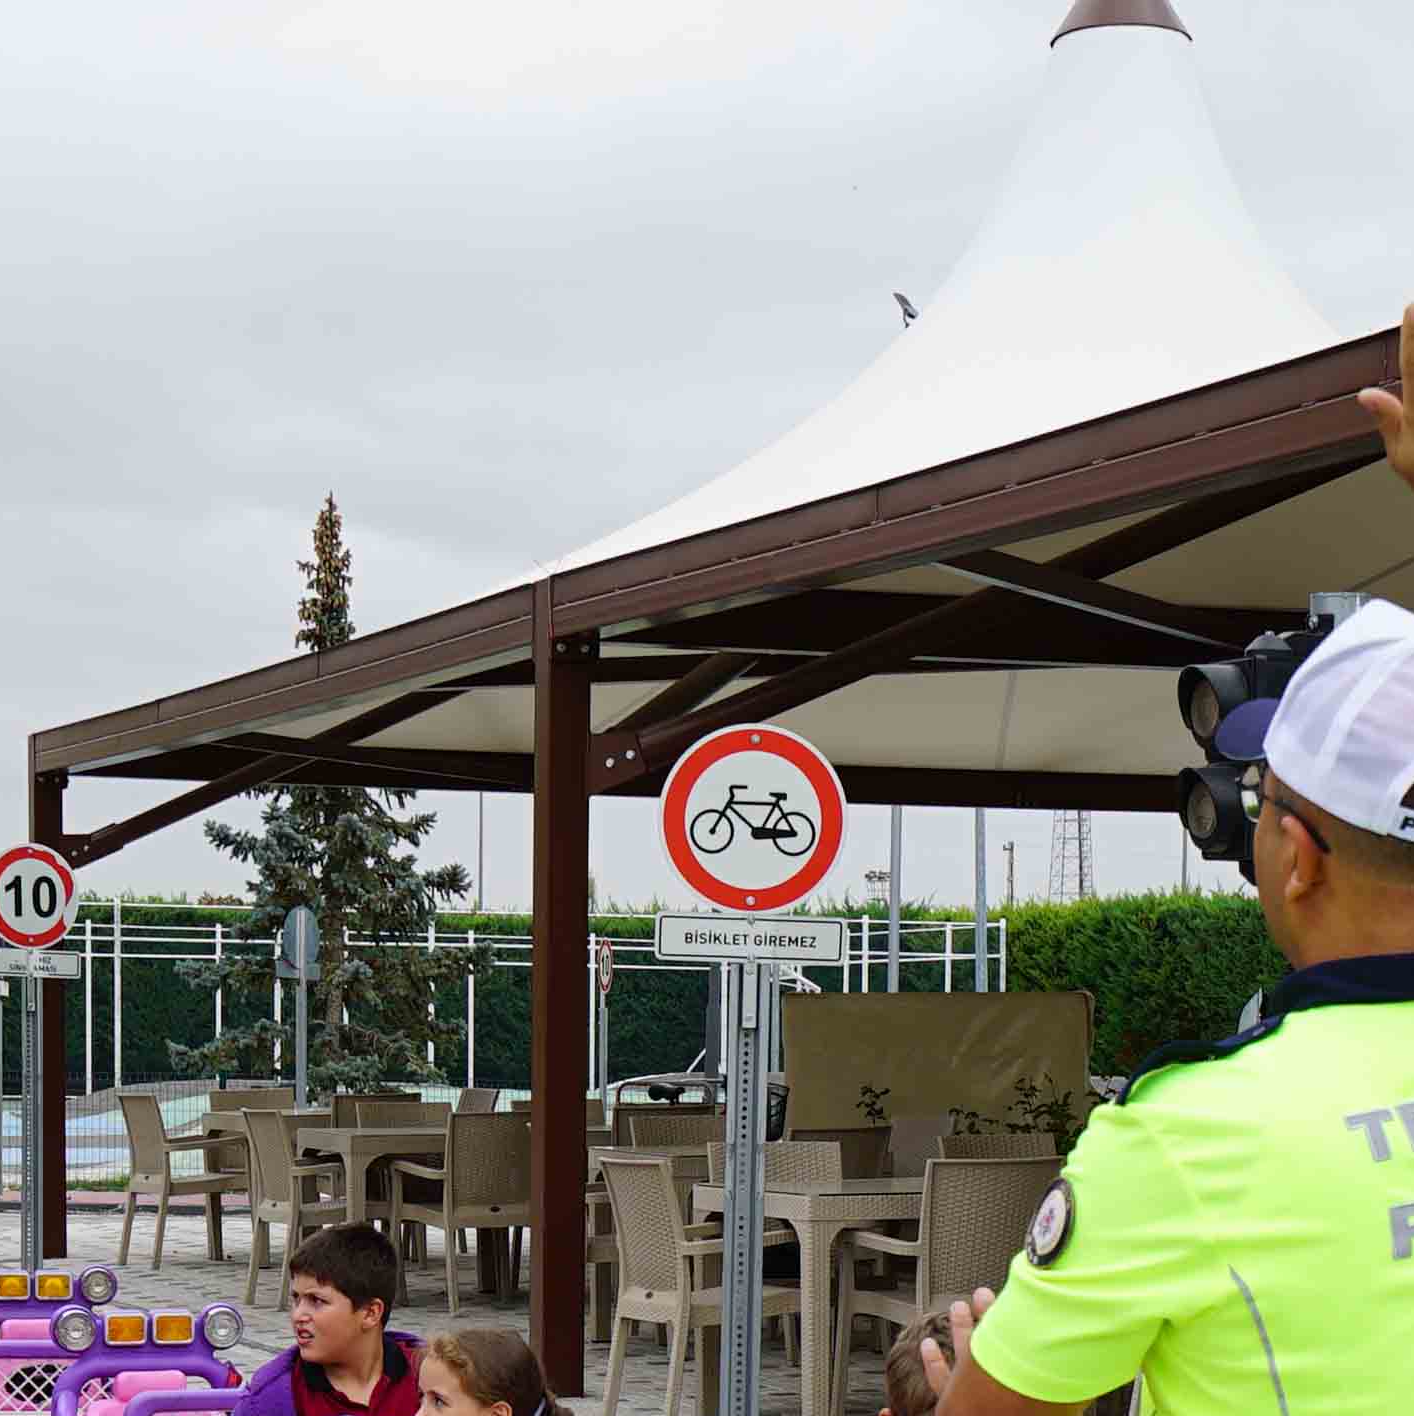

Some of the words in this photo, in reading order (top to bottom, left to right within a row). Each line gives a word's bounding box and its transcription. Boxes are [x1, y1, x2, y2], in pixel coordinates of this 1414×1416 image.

[5, 875, 57, 918] 10
[684, 930, 749, 946] BİSİKLET
[754, 930, 817, 948] GİREMEZ
